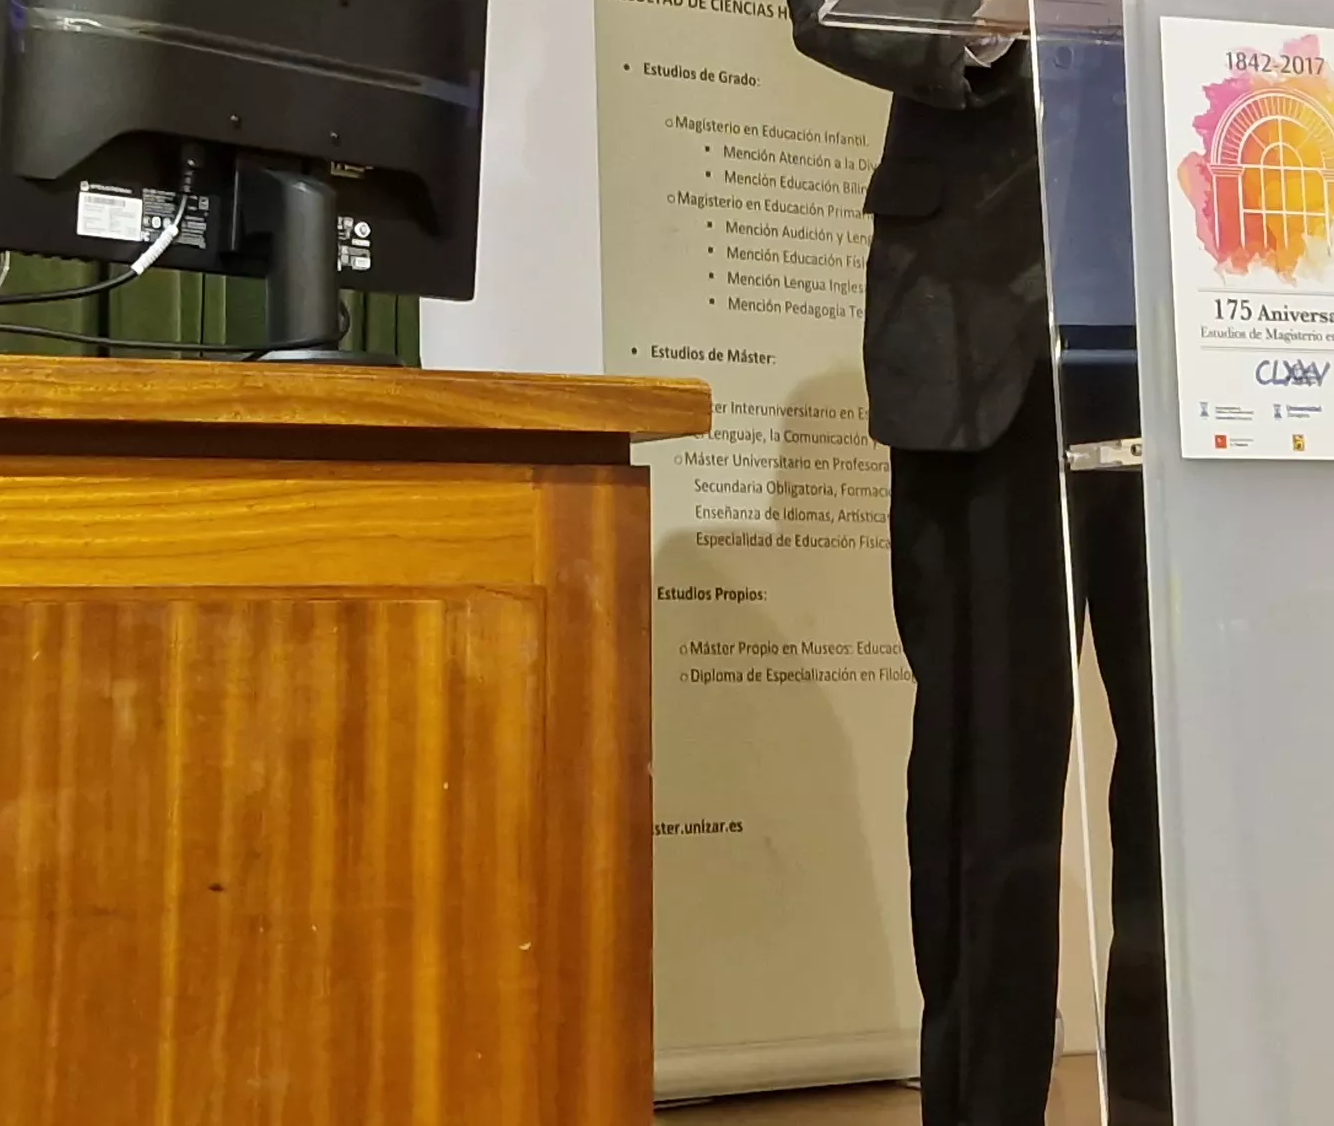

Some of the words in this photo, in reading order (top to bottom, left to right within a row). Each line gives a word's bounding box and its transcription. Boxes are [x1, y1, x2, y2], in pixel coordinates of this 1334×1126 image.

[778, 5, 790, 20] H
[1225, 51, 1325, 75] 1842-2017
[644, 62, 696, 80] Estudios
[700, 68, 715, 82] de
[718, 70, 761, 87] Grado:
[676, 116, 741, 134] Magisterio
[744, 125, 758, 136] en
[762, 125, 821, 143] Educación
[723, 145, 775, 163] Mención
[779, 151, 831, 168] Atención
[834, 159, 842, 169] a
[845, 158, 854, 170] la
[724, 170, 776, 188] Mención
[780, 177, 839, 194] Educación
[677, 191, 742, 209] Magisterio
[746, 199, 761, 210] en
[765, 199, 824, 216] Educación
[726, 221, 778, 238] Mención
[782, 226, 833, 244] Audición
[836, 233, 844, 246] y
[727, 246, 779, 263] Mención
[783, 250, 842, 268] Educación
[846, 255, 867, 269] Físi
[727, 271, 780, 288] Mención
[784, 276, 826, 293] Lengua
[830, 280, 865, 295] Ingles
[728, 297, 781, 314] Mención
[1214, 298, 1252, 321] 175
[1200, 324, 1246, 340] Estudios
[1249, 328, 1262, 340] de
[1266, 328, 1322, 344] Magisterio
[651, 344, 705, 361] Estudios
[708, 348, 724, 362] de
[727, 348, 777, 365] Máster:
[731, 401, 836, 419] Interuniversitario
[839, 407, 855, 419] en
[708, 428, 766, 445] Lenguaje,
[770, 428, 780, 442] la
[784, 429, 868, 446] Comunicación
[684, 451, 729, 467] Máster
[732, 453, 811, 470] Universitario
[814, 458, 829, 470] en
[694, 478, 763, 494] Secundaria
[766, 480, 837, 498] Obligatoria,
[695, 505, 761, 521] Enseñanza
[764, 506, 780, 521] de
[783, 507, 834, 524] Idiomas,
[838, 509, 890, 523] Artística
[696, 532, 772, 548] Especialidad
[776, 534, 791, 548] de
[795, 534, 856, 549] Educación
[657, 586, 712, 601] Estudios
[715, 586, 767, 604] Propios:
[690, 641, 735, 656] Máster
[738, 642, 779, 658] Propio
[782, 644, 797, 656] en
[690, 669, 743, 685] Diploma
[746, 668, 762, 682] de
[766, 668, 857, 685] Especialización
[860, 671, 875, 682] en
